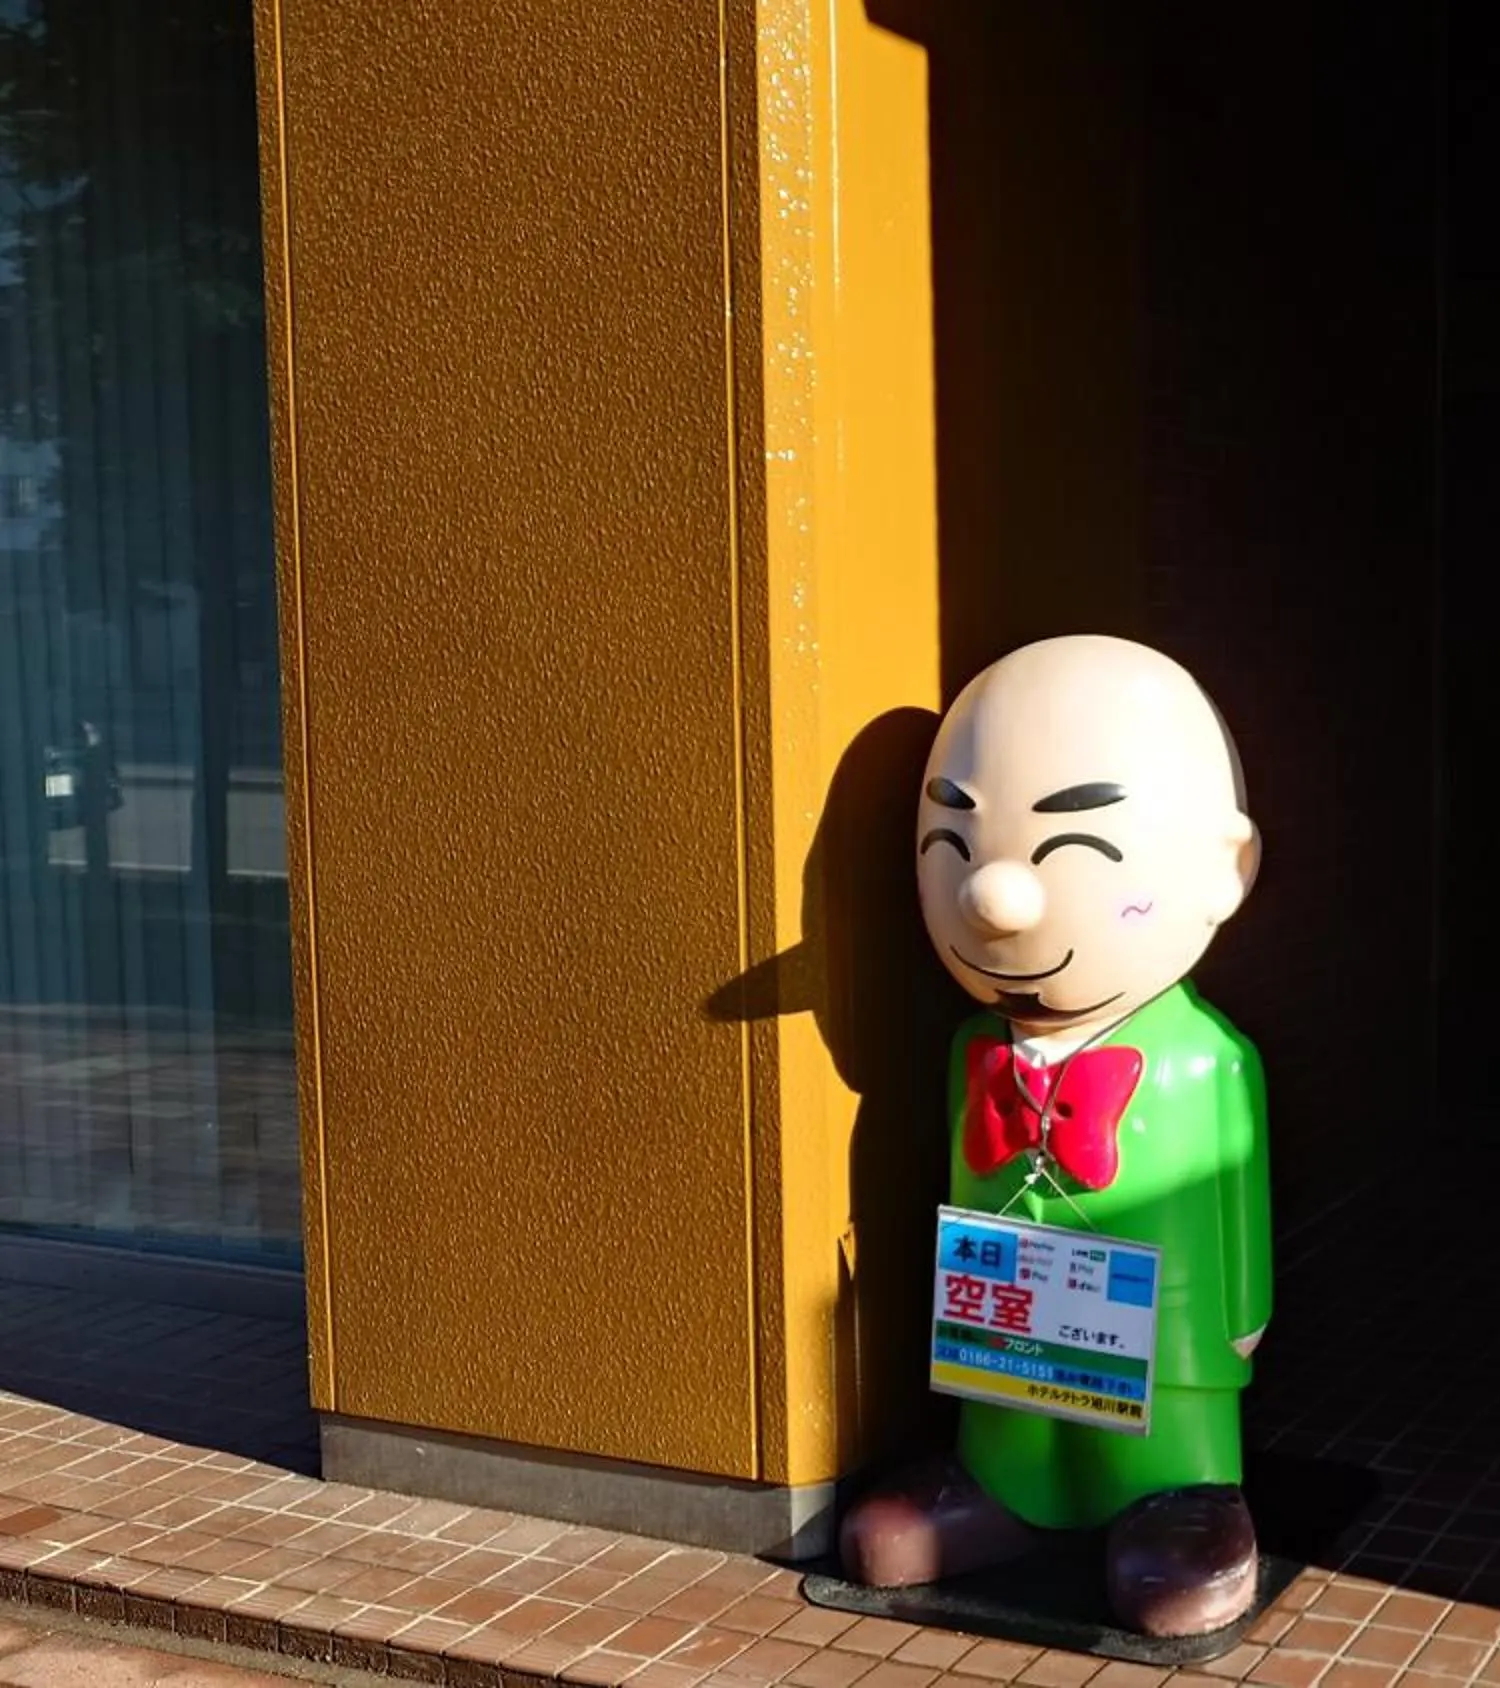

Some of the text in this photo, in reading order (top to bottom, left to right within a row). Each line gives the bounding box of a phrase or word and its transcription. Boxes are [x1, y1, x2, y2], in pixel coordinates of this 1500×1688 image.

[953, 1235, 1002, 1267] 本日
[943, 1275, 1033, 1334] 空室
[1006, 1338, 1044, 1357] フロント
[1058, 1324, 1126, 1349] ございます。
